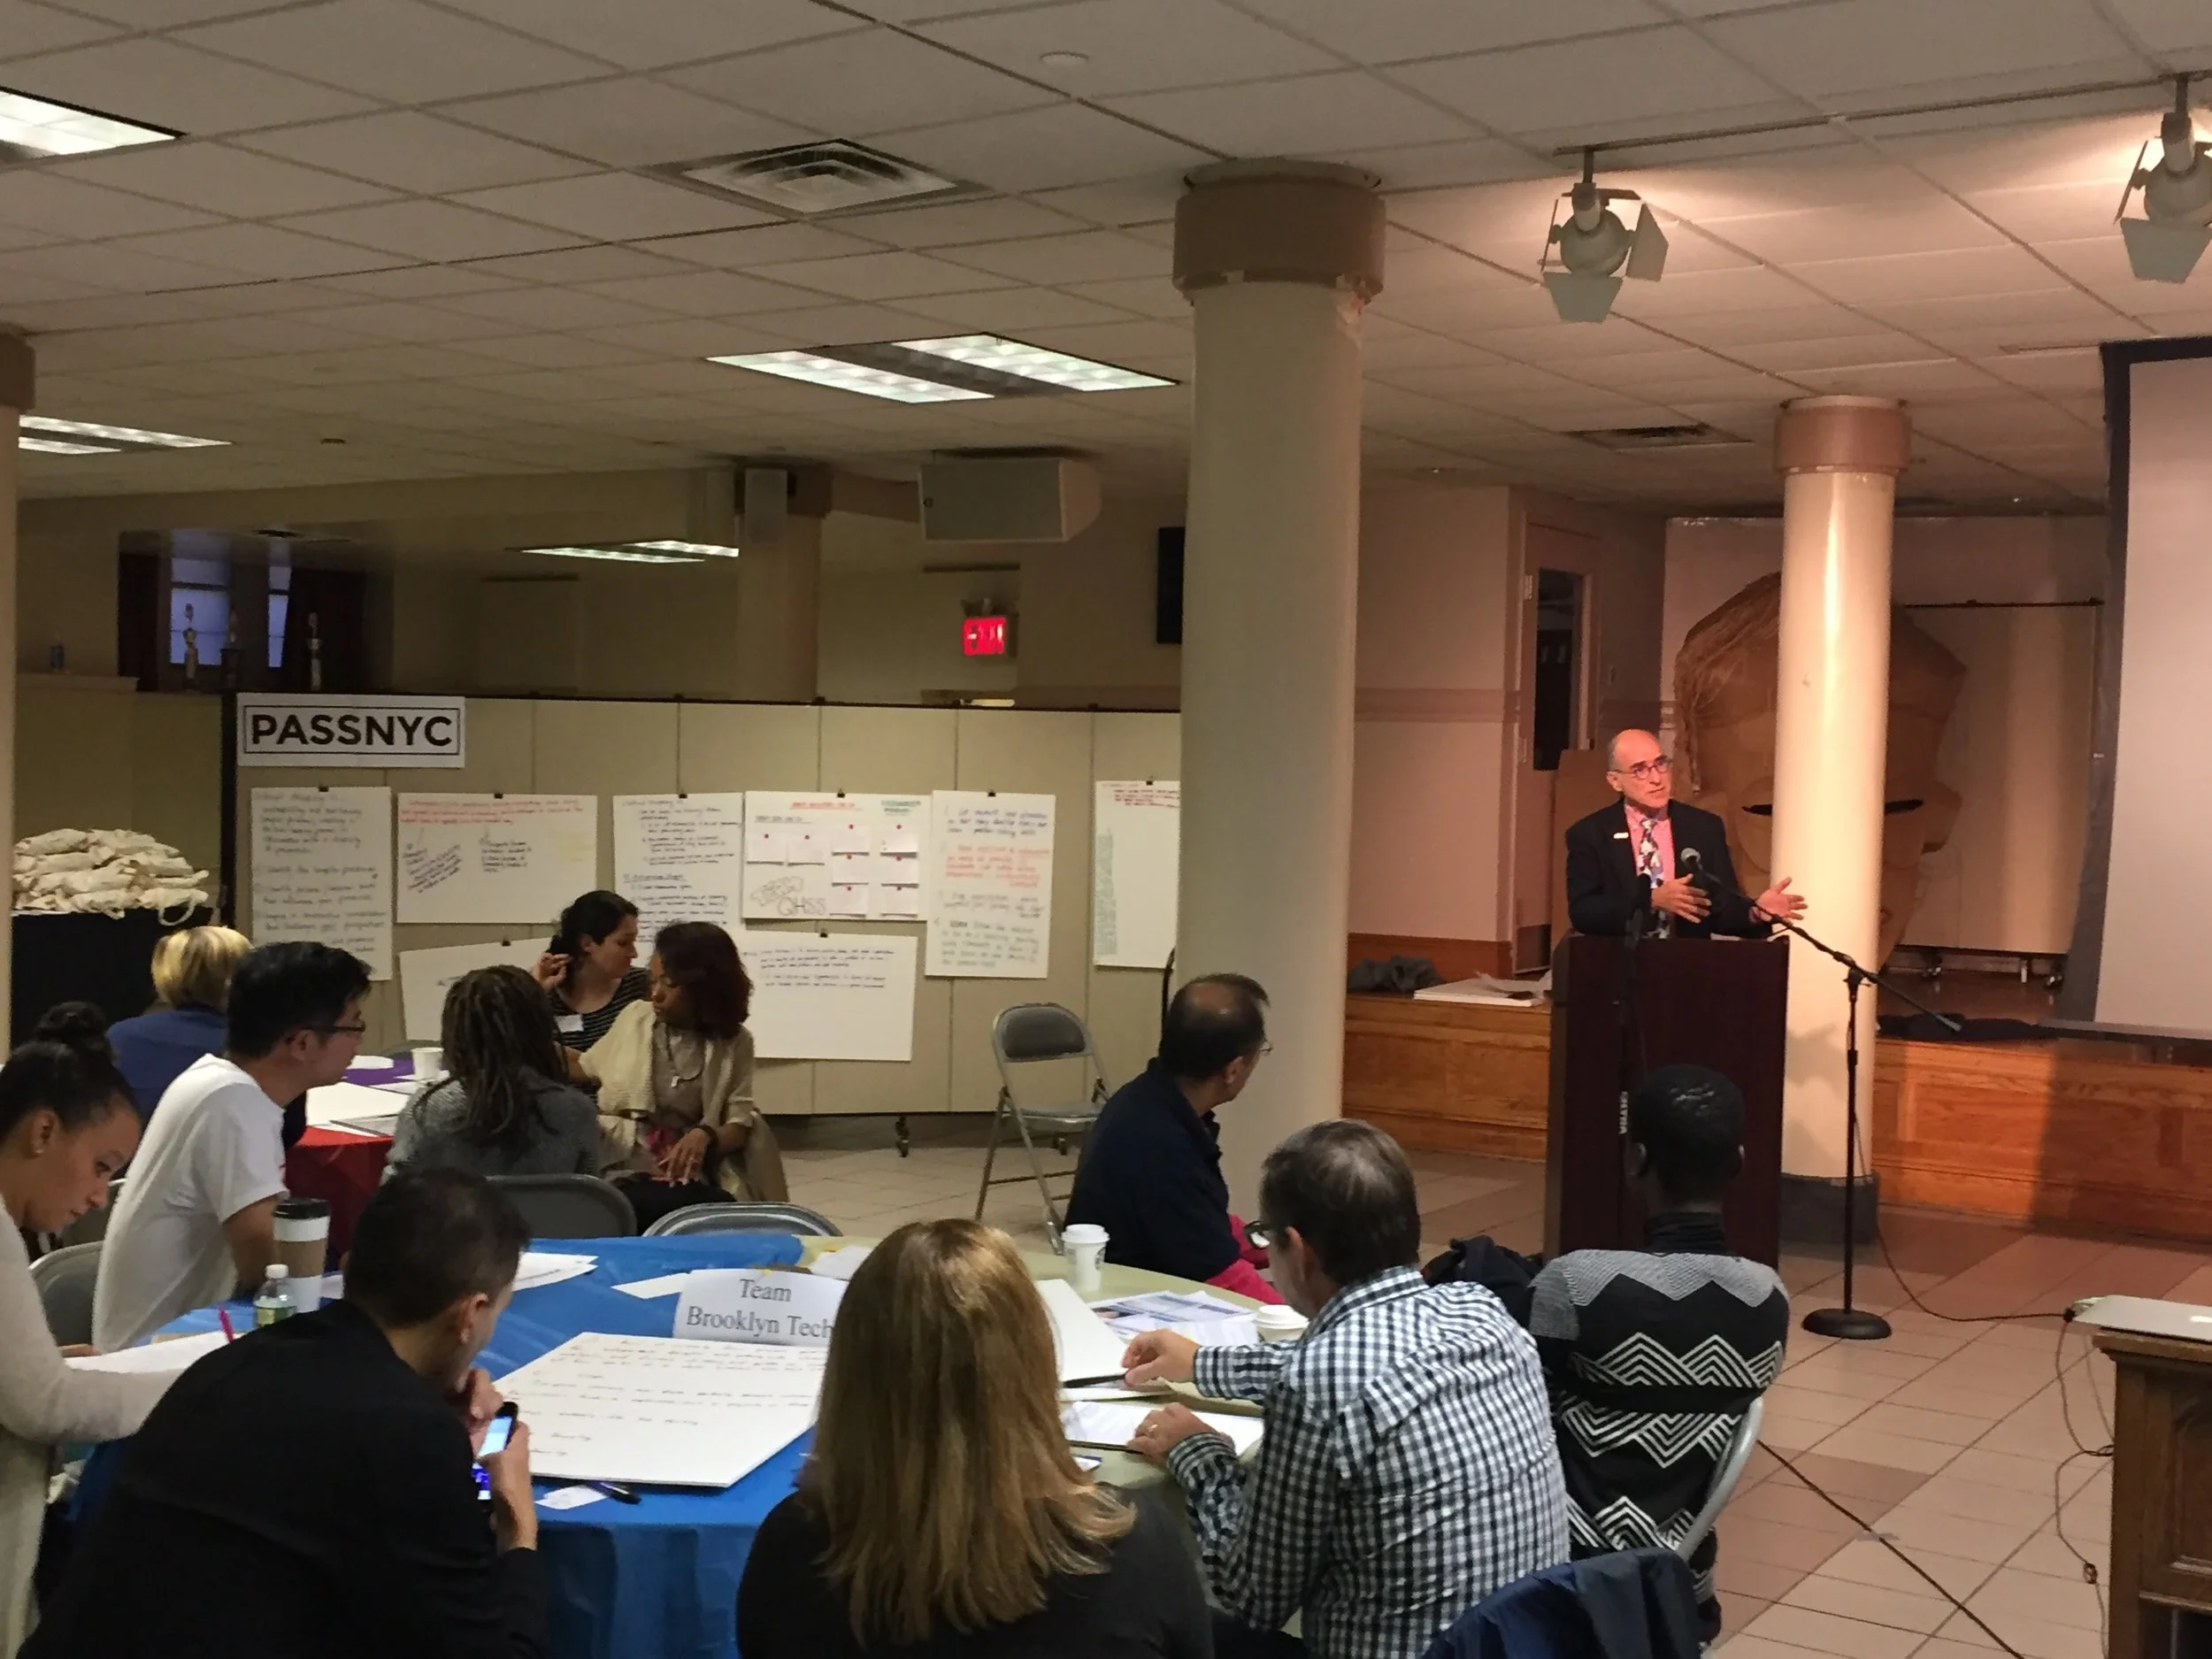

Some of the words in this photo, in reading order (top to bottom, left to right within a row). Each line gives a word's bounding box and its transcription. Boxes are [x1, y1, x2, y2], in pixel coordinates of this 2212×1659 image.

[251, 714, 453, 747] PASSNYC
[740, 1279, 792, 1302] Team
[687, 1305, 780, 1337] Brooklyn
[787, 1315, 835, 1339] Tech
